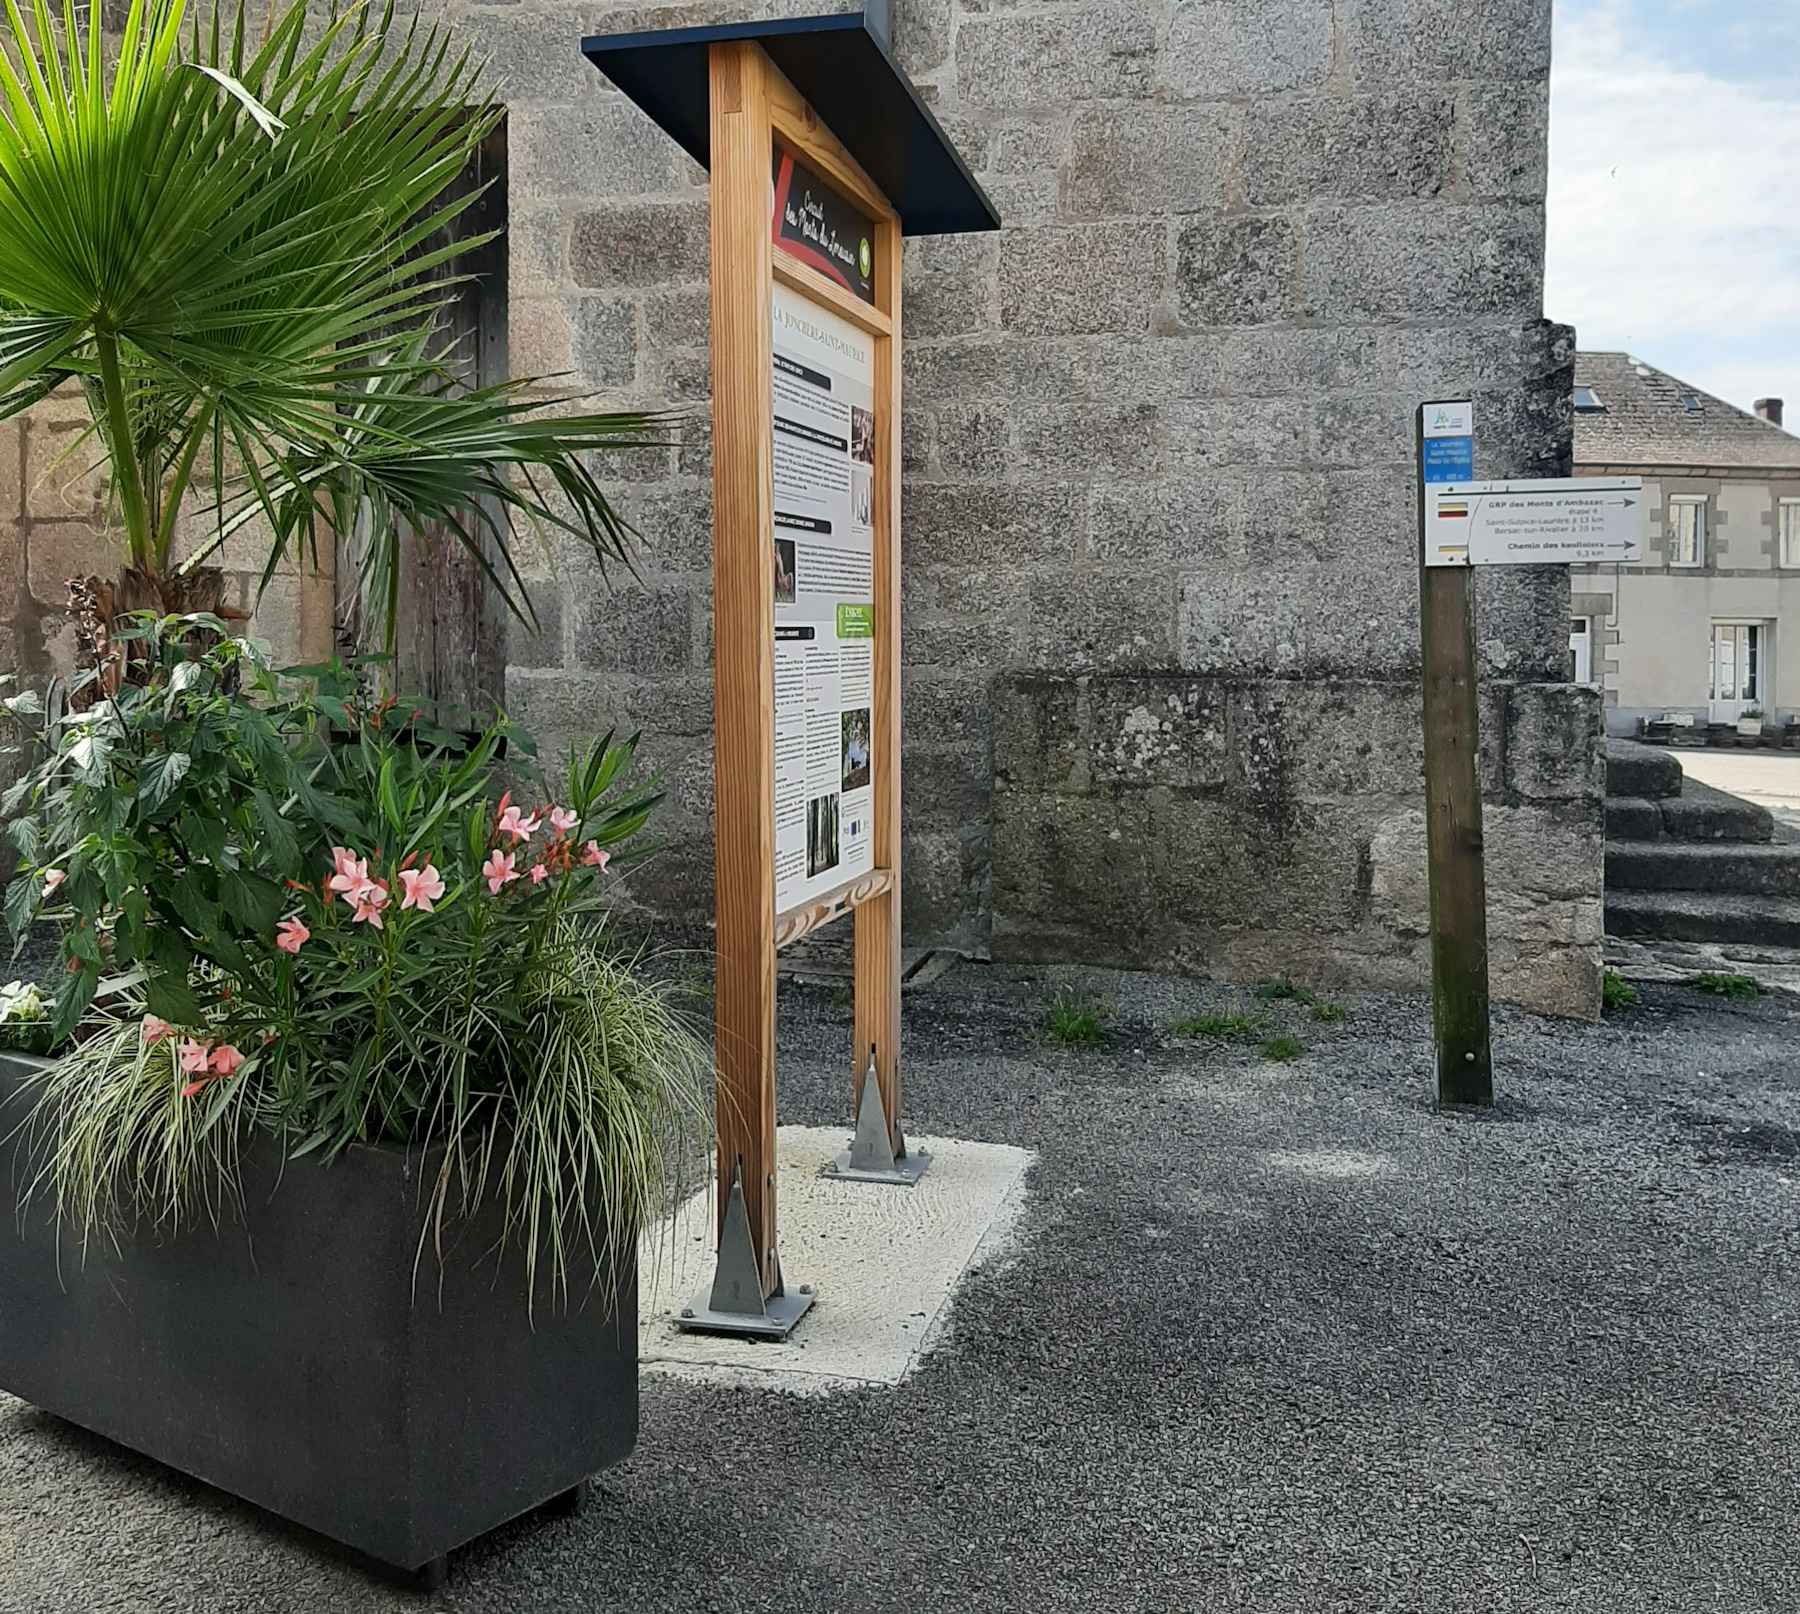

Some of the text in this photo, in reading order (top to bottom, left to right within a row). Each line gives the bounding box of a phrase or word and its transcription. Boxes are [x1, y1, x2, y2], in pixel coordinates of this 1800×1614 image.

[773, 305, 783, 323] LA
[1488, 501, 1507, 509] GRP
[1527, 500, 1554, 508] Monts
[1556, 498, 1604, 507] d'Ambazac
[1485, 516, 1570, 526] Saint-Sulpice-Laurière
[1494, 525, 1569, 534] Bersac-sur-Rivalier
[1507, 542, 1541, 550] Chemin
[1561, 541, 1604, 549] kaoliniers
[1576, 550, 1589, 558] 9,3
